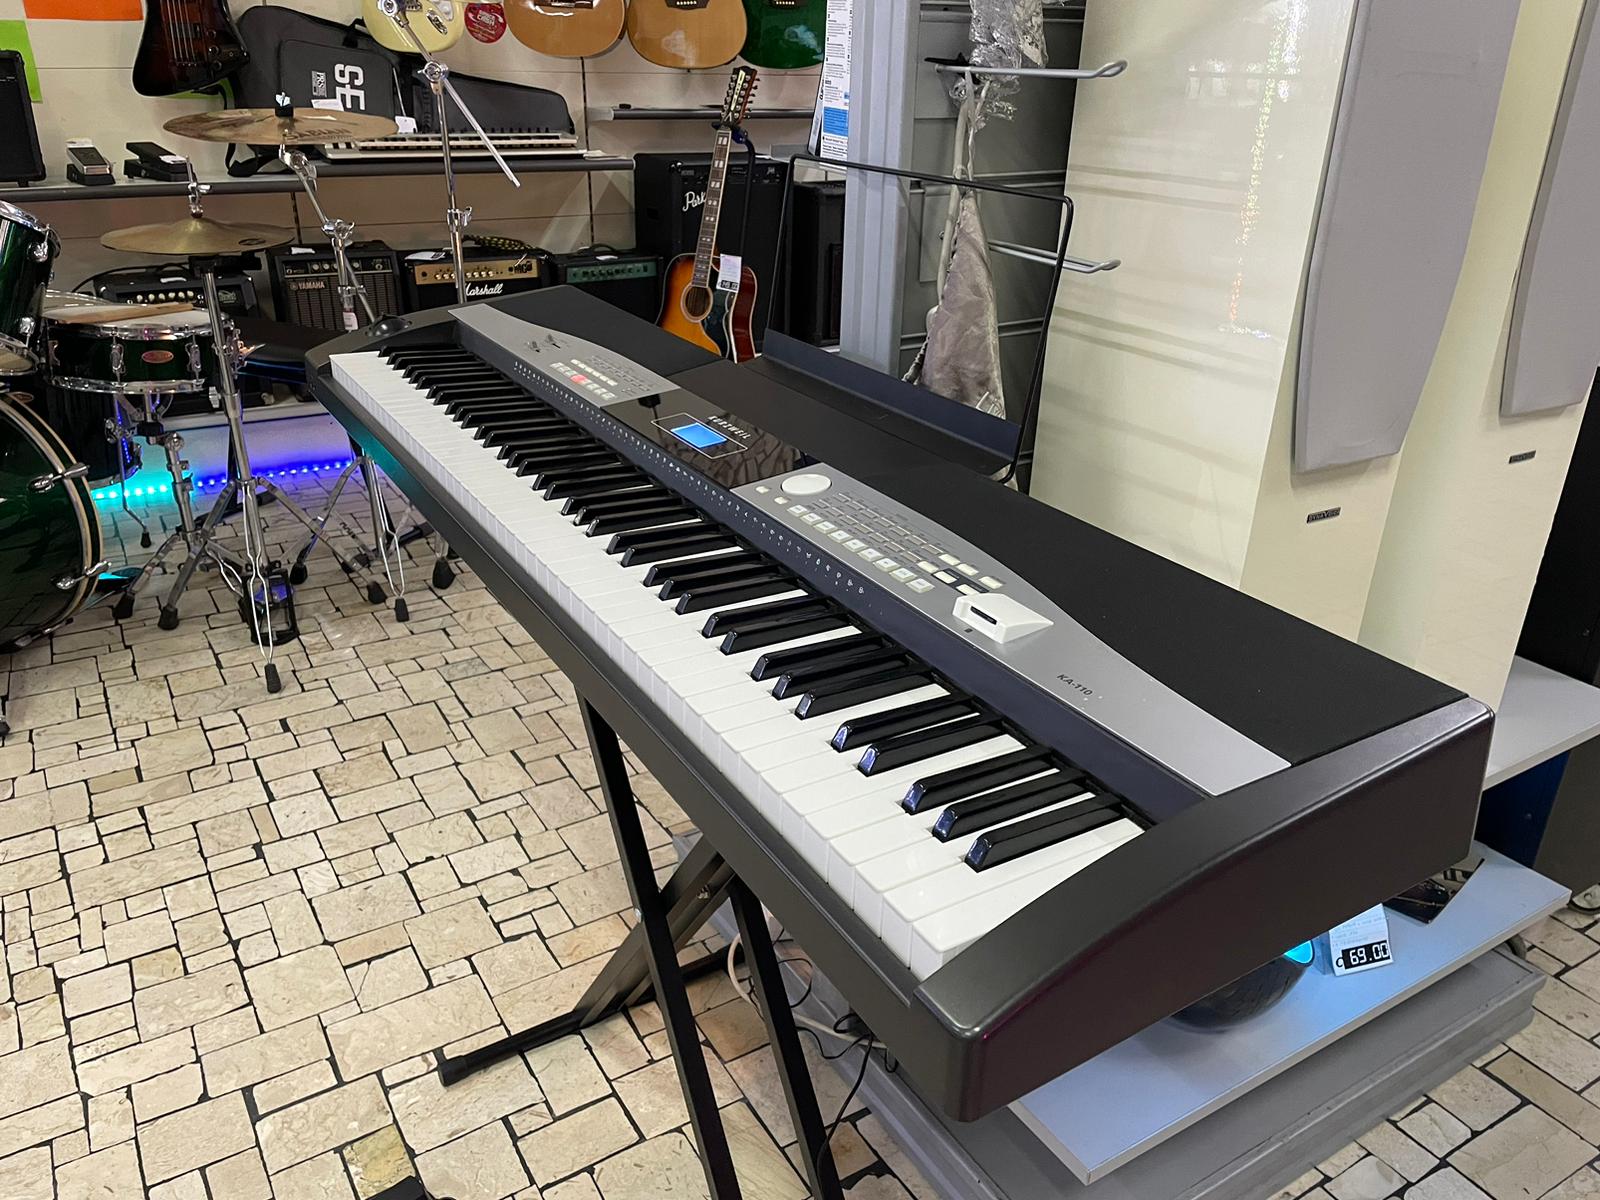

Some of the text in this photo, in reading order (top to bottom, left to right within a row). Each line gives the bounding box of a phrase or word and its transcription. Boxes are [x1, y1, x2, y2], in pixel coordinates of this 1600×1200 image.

[335, 63, 366, 110] SE
[298, 281, 325, 290] YAMAHA
[465, 283, 503, 296] arshall
[707, 415, 751, 439] KURZWEIL
[1056, 674, 1093, 696] KA-110
[1349, 942, 1389, 966] 69.00
